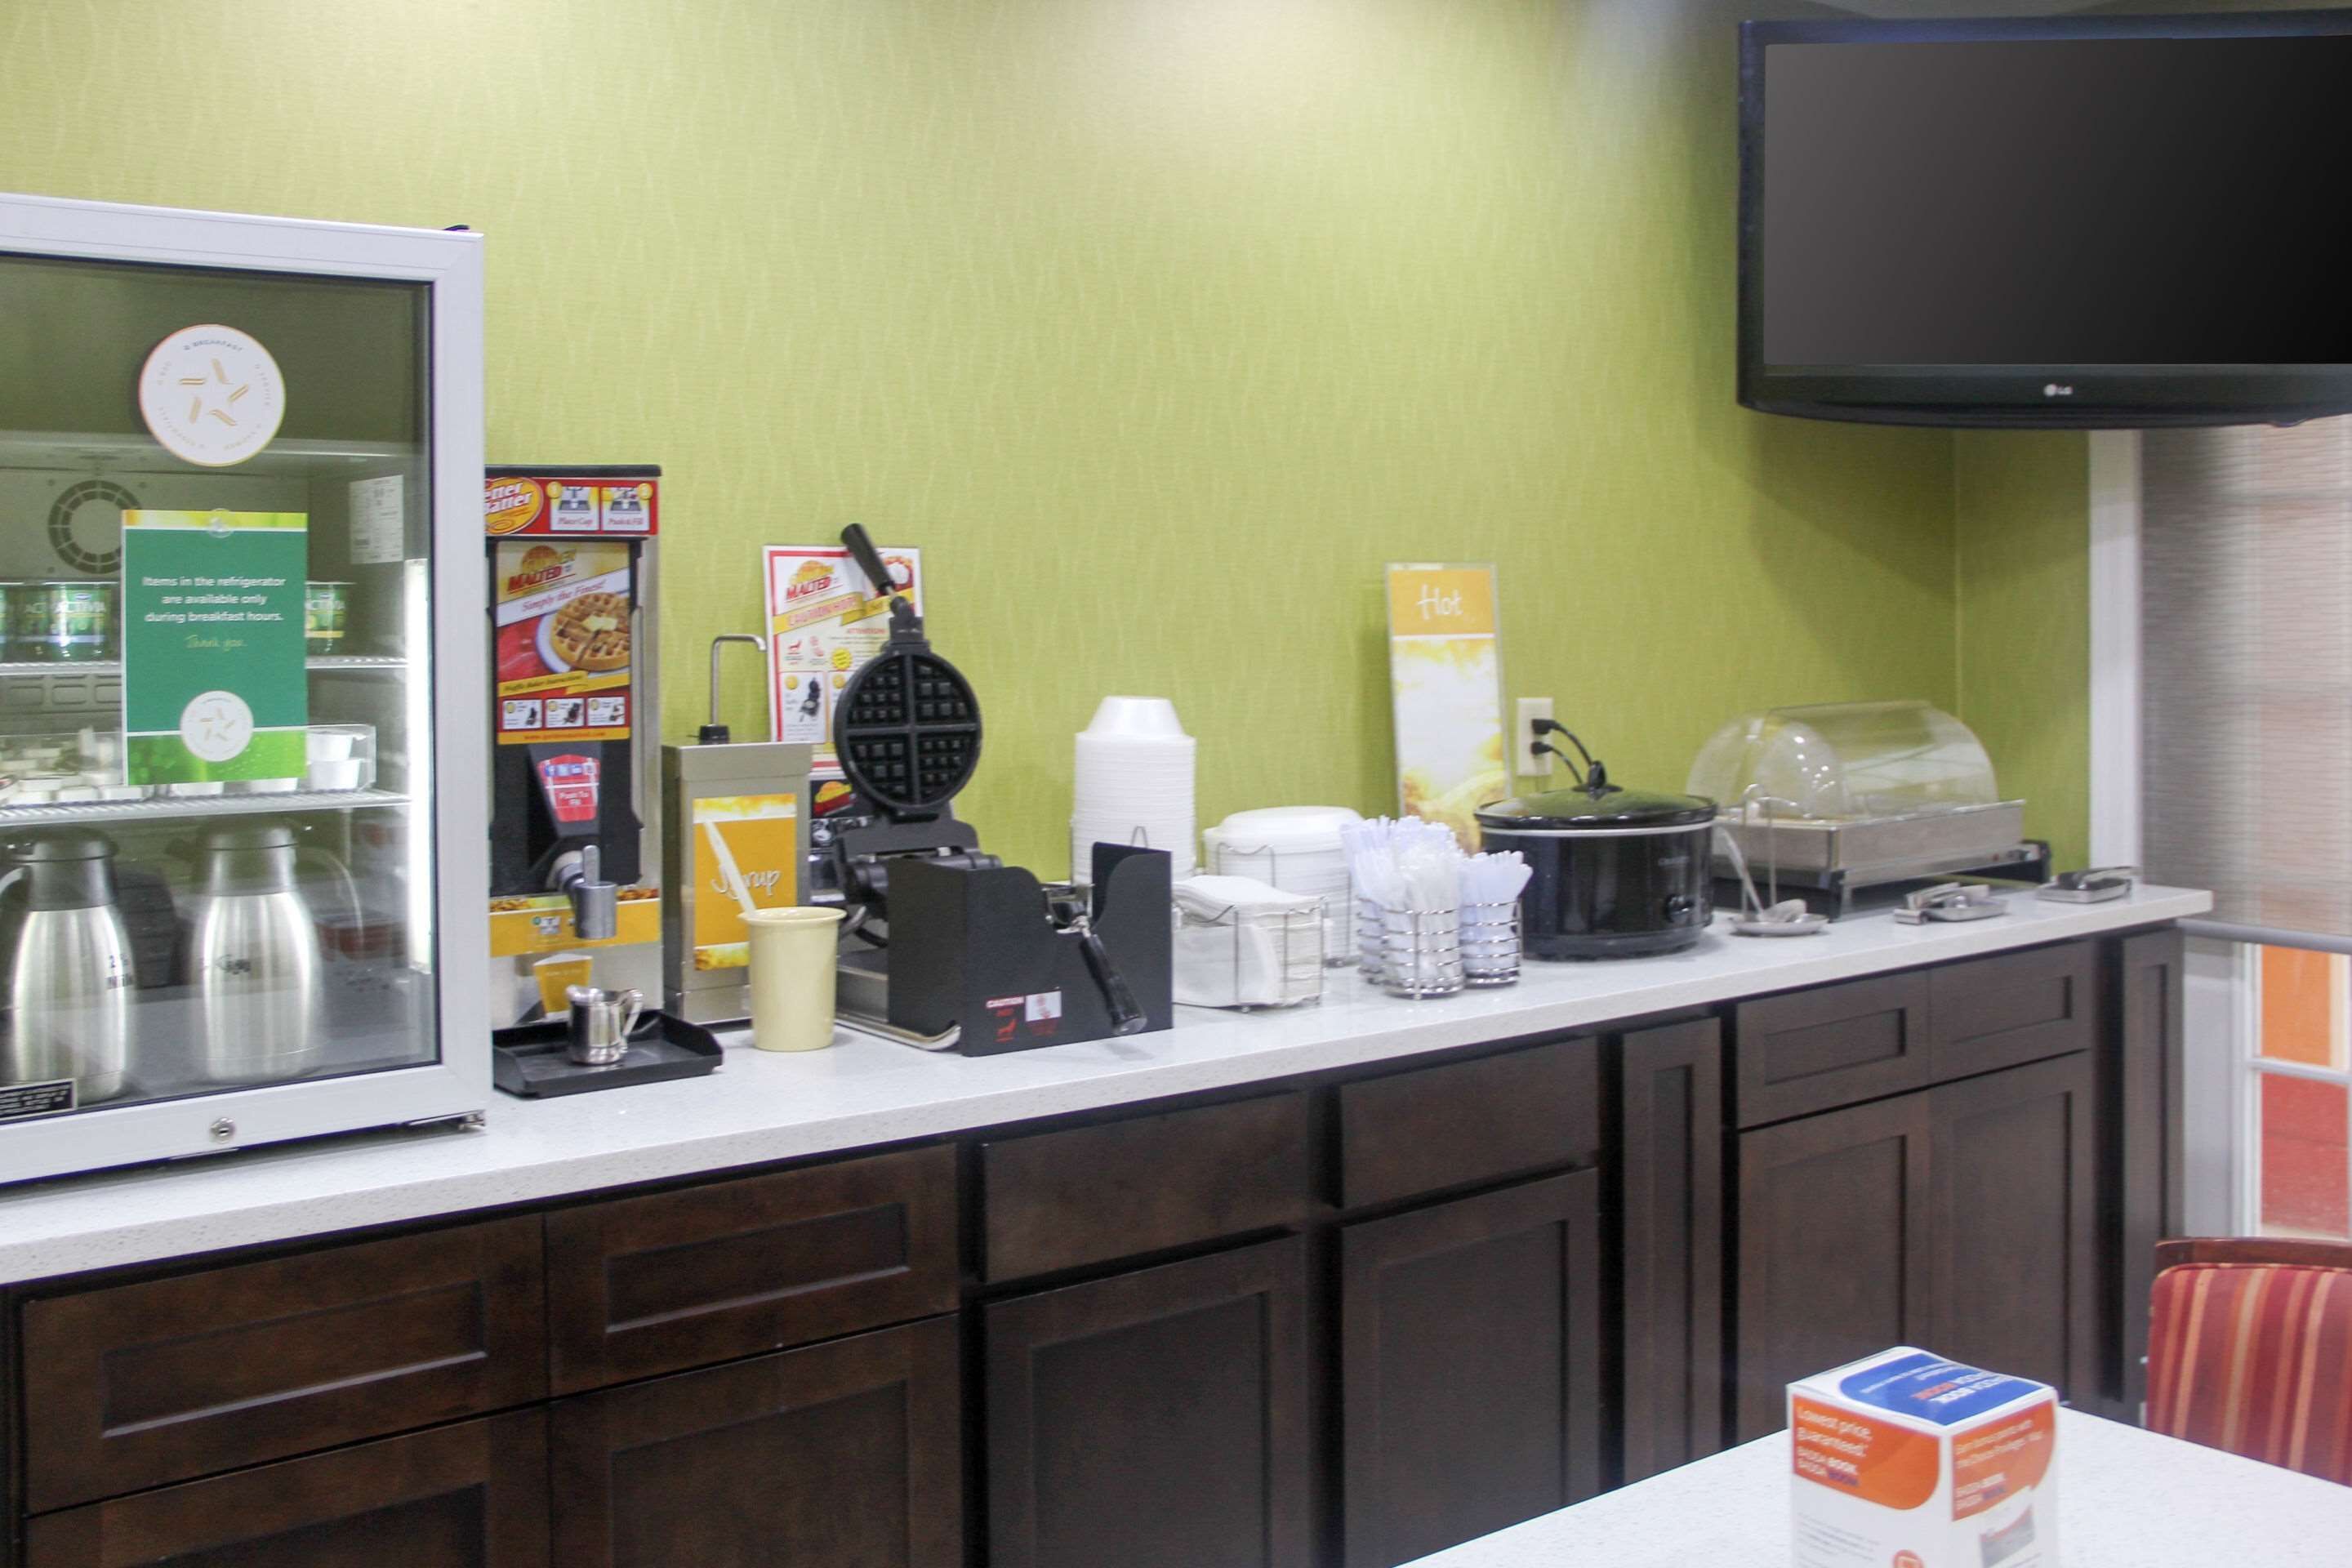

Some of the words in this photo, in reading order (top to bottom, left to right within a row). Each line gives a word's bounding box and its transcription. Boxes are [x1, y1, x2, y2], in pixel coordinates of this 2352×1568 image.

[142, 576, 178, 586] Items
[180, 576, 193, 586] in
[194, 576, 216, 586] the
[216, 575, 287, 588] refrigerator
[162, 596, 183, 604] are
[184, 594, 239, 604] available
[240, 594, 268, 606] only
[1414, 583, 1464, 621] Hot
[144, 612, 186, 624] during
[187, 611, 245, 621] breakfast
[247, 611, 284, 621] hours.
